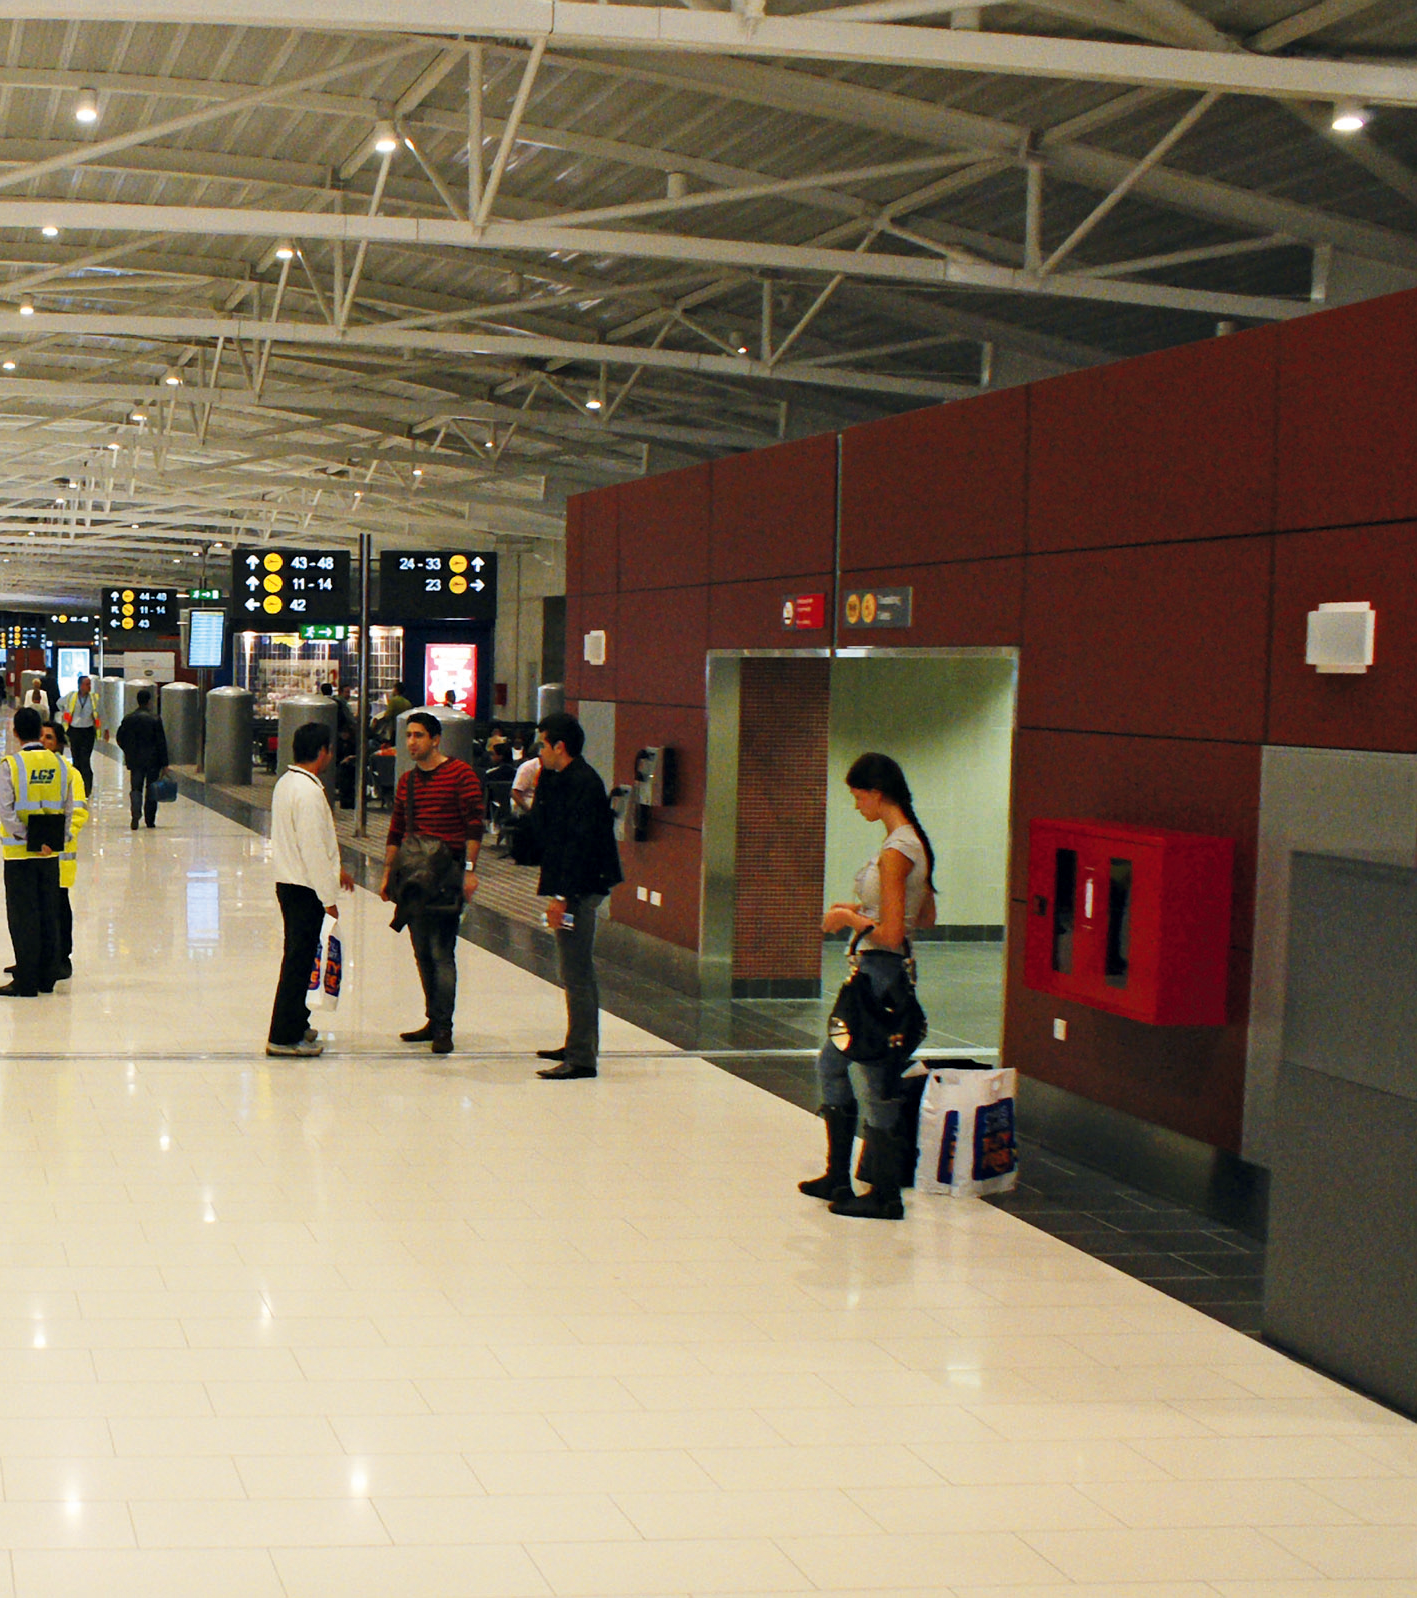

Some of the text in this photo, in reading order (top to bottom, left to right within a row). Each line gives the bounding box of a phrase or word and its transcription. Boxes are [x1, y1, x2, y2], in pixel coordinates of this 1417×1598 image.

[291, 556, 308, 570] 43
[317, 556, 334, 570] 48
[399, 557, 415, 570] 24
[425, 557, 441, 570] 33
[292, 577, 305, 590] 11
[317, 577, 333, 591] 14
[425, 578, 441, 591] 23
[139, 592, 150, 601] 44
[139, 605, 149, 614] 11
[156, 605, 166, 615] 14
[289, 598, 307, 612] 42
